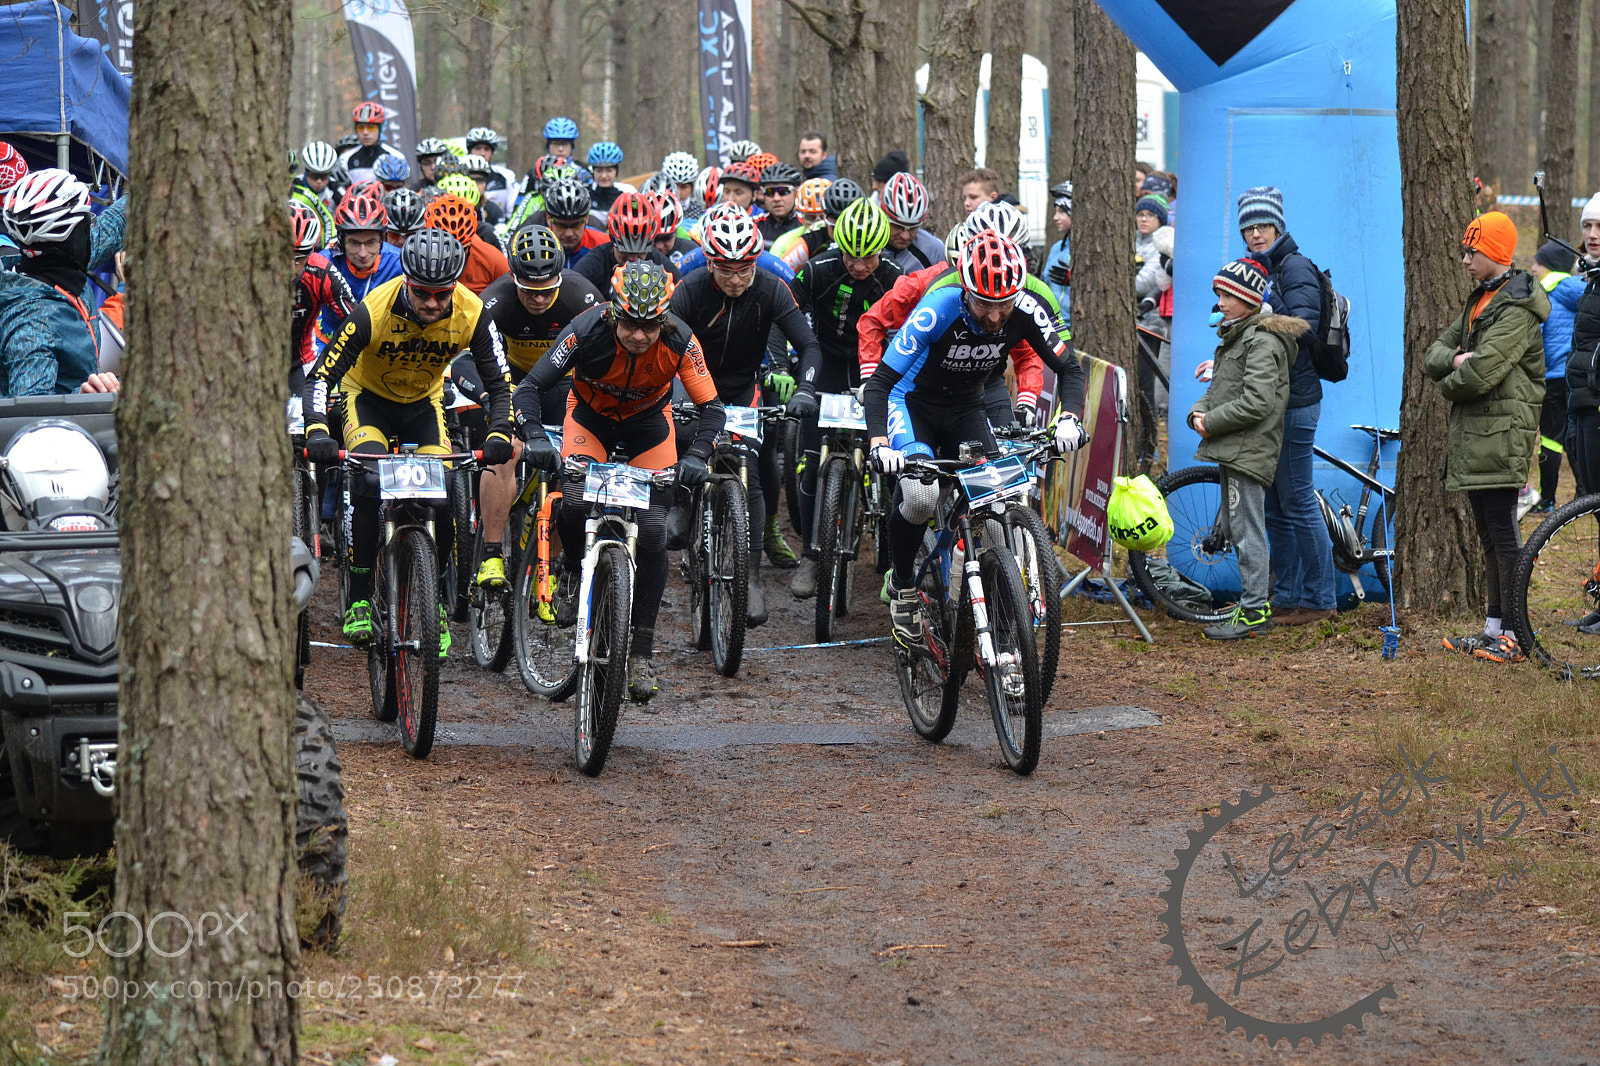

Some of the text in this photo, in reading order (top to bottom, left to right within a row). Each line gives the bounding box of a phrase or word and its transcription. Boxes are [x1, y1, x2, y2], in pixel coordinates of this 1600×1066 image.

[1221, 261, 1268, 296] UNTE
[398, 464, 427, 486] 90
[984, 465, 1002, 486] 3
